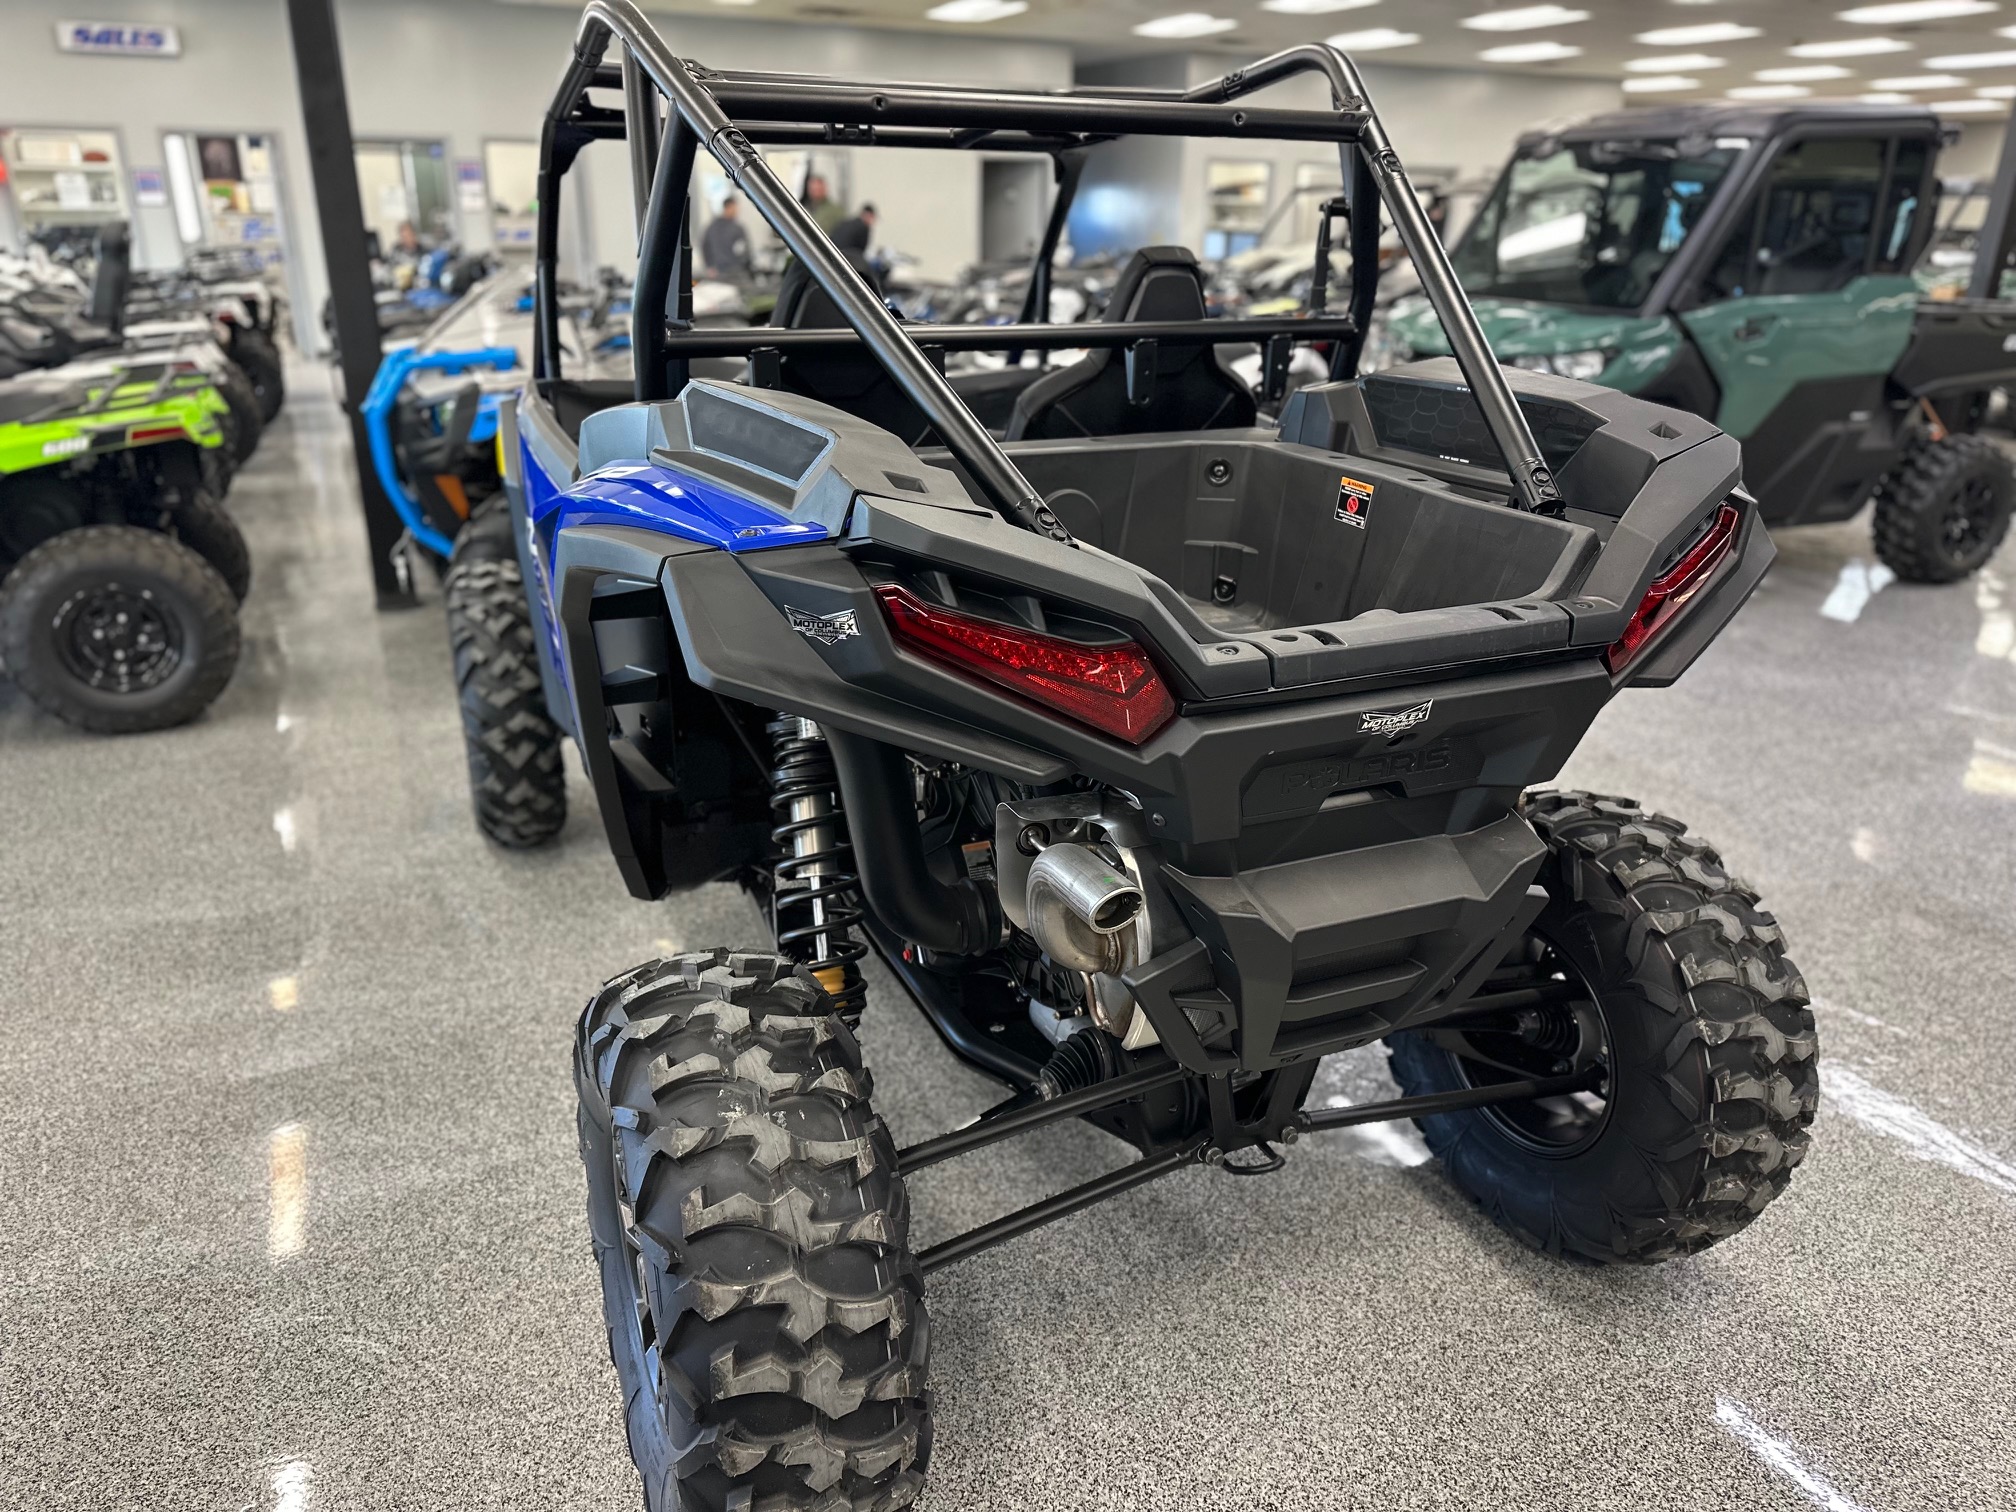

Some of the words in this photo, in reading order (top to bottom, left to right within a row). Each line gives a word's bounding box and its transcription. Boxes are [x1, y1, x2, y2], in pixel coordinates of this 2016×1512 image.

[793, 618, 855, 632] MOTOPLEX
[1361, 710, 1427, 730] MOTOPLEX
[1281, 747, 1452, 796] POLARIS
